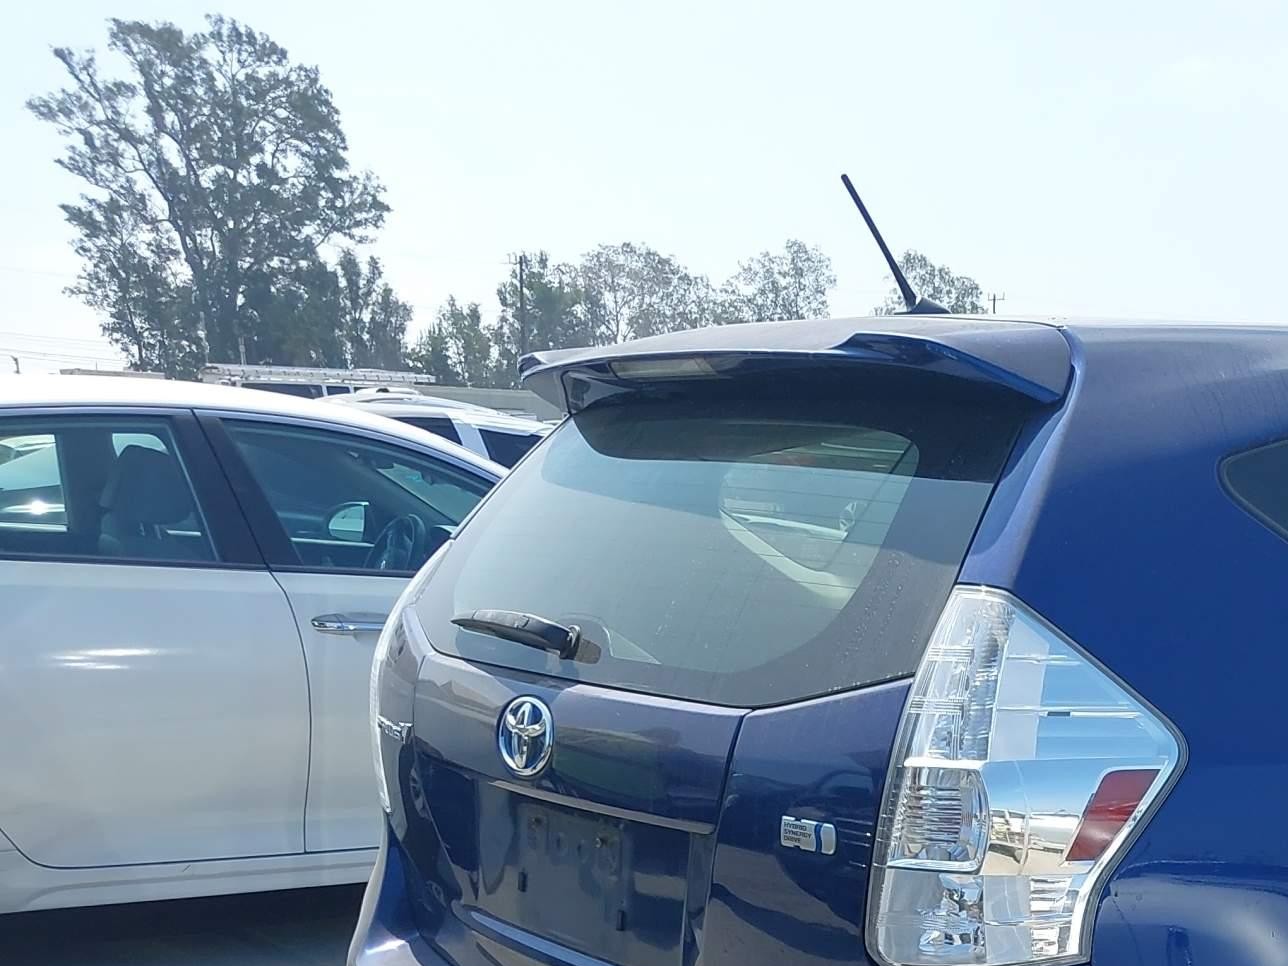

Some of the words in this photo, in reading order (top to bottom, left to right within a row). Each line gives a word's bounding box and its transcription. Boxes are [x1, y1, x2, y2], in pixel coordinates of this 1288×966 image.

[783, 821, 808, 832] HYBRID
[783, 828, 812, 839] SYNERGY
[783, 834, 802, 844] DRIVE
